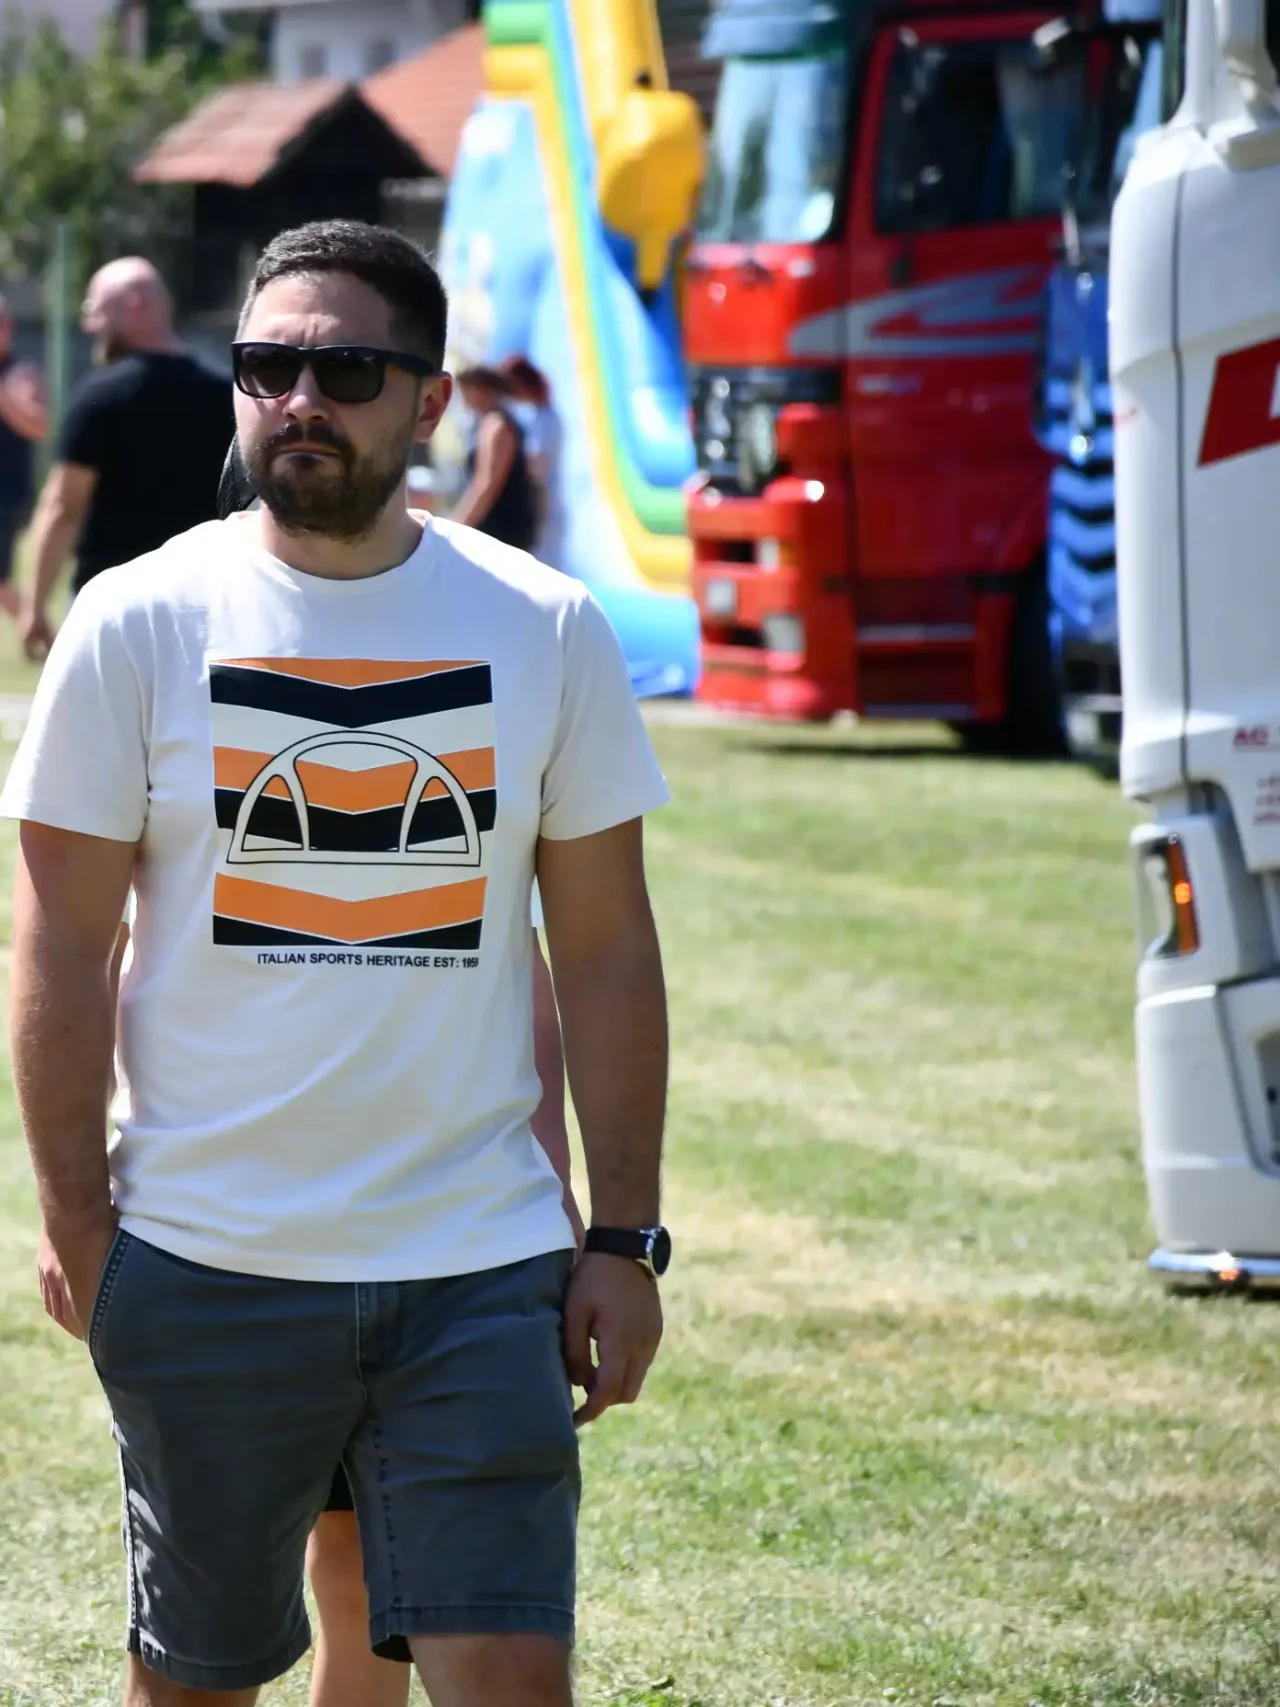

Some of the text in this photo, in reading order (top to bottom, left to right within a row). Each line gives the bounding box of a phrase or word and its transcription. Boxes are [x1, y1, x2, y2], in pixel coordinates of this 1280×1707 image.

[257, 953, 306, 964] ITALIAN
[309, 953, 362, 965] SPORTS
[366, 955, 430, 967] HERITAGE
[433, 956, 460, 968] EST:
